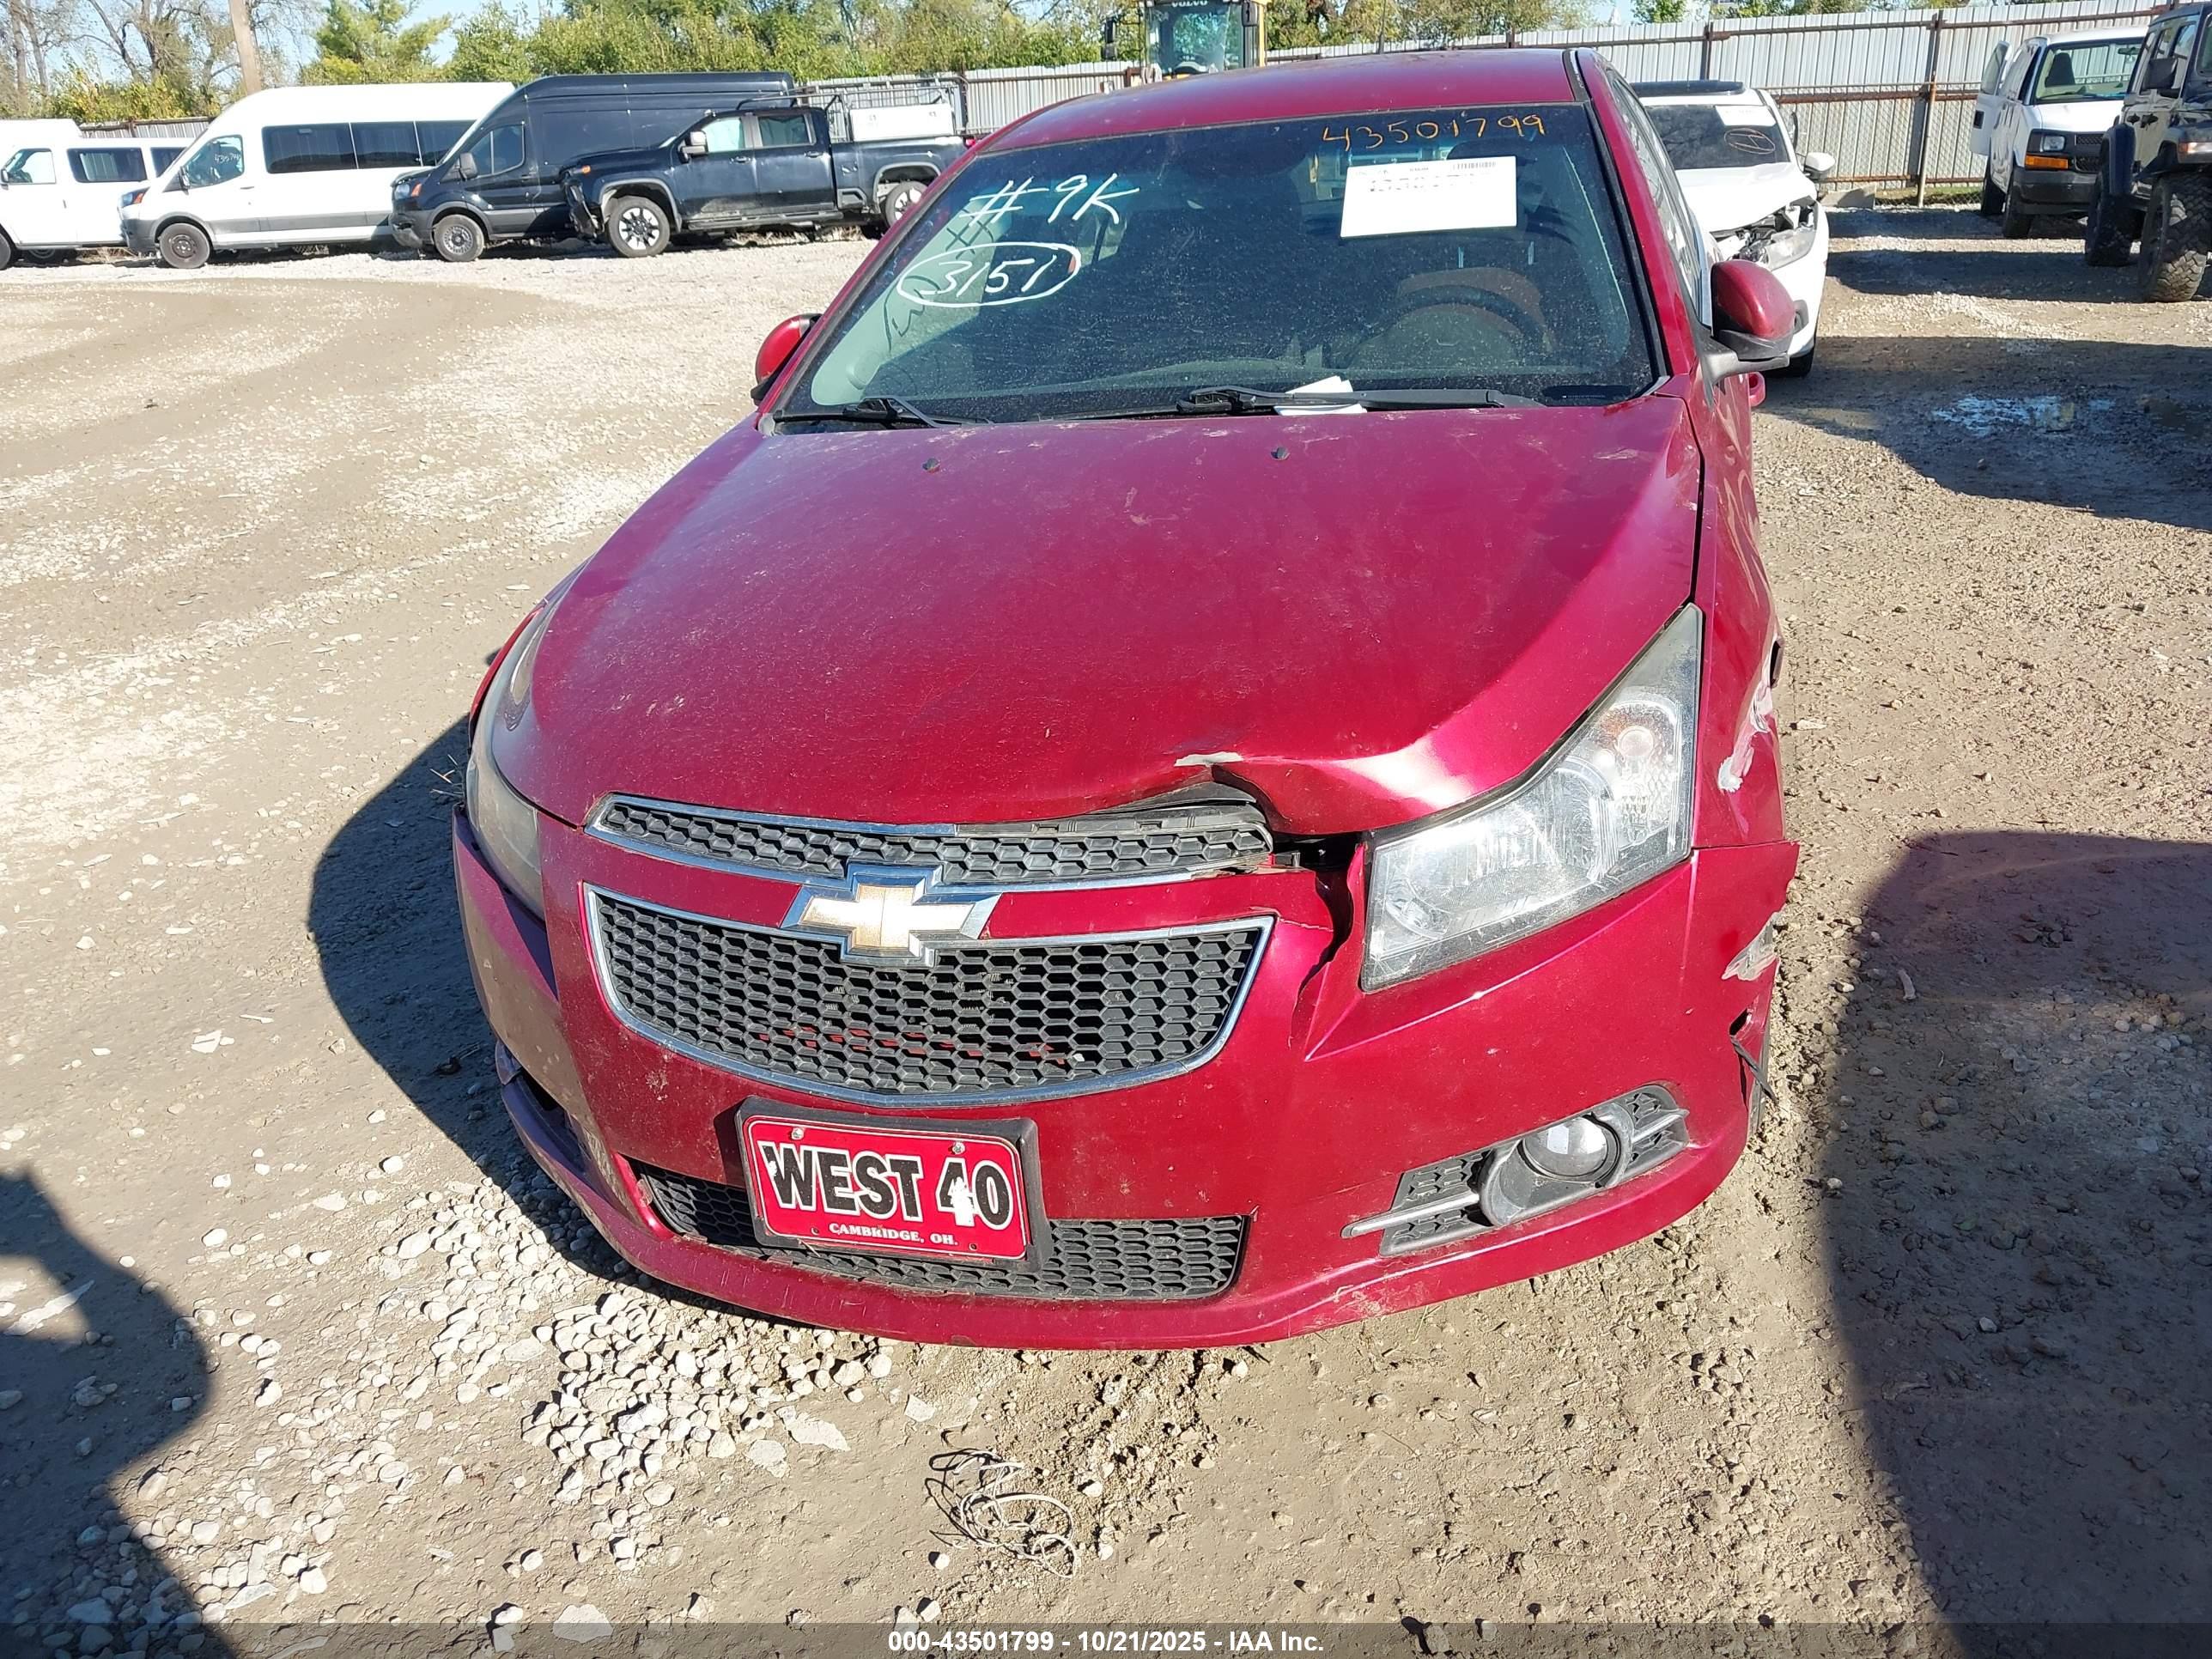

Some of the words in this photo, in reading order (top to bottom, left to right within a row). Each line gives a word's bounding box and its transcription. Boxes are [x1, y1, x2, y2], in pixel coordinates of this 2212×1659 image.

[1322, 114, 1547, 152] 43501799
[920, 254, 1058, 297] 3151
[757, 1139, 924, 1223] WEST
[935, 1157, 1014, 1231] 40
[829, 1223, 925, 1243] CAMBRIDGE,
[930, 1233, 958, 1245] OH.
